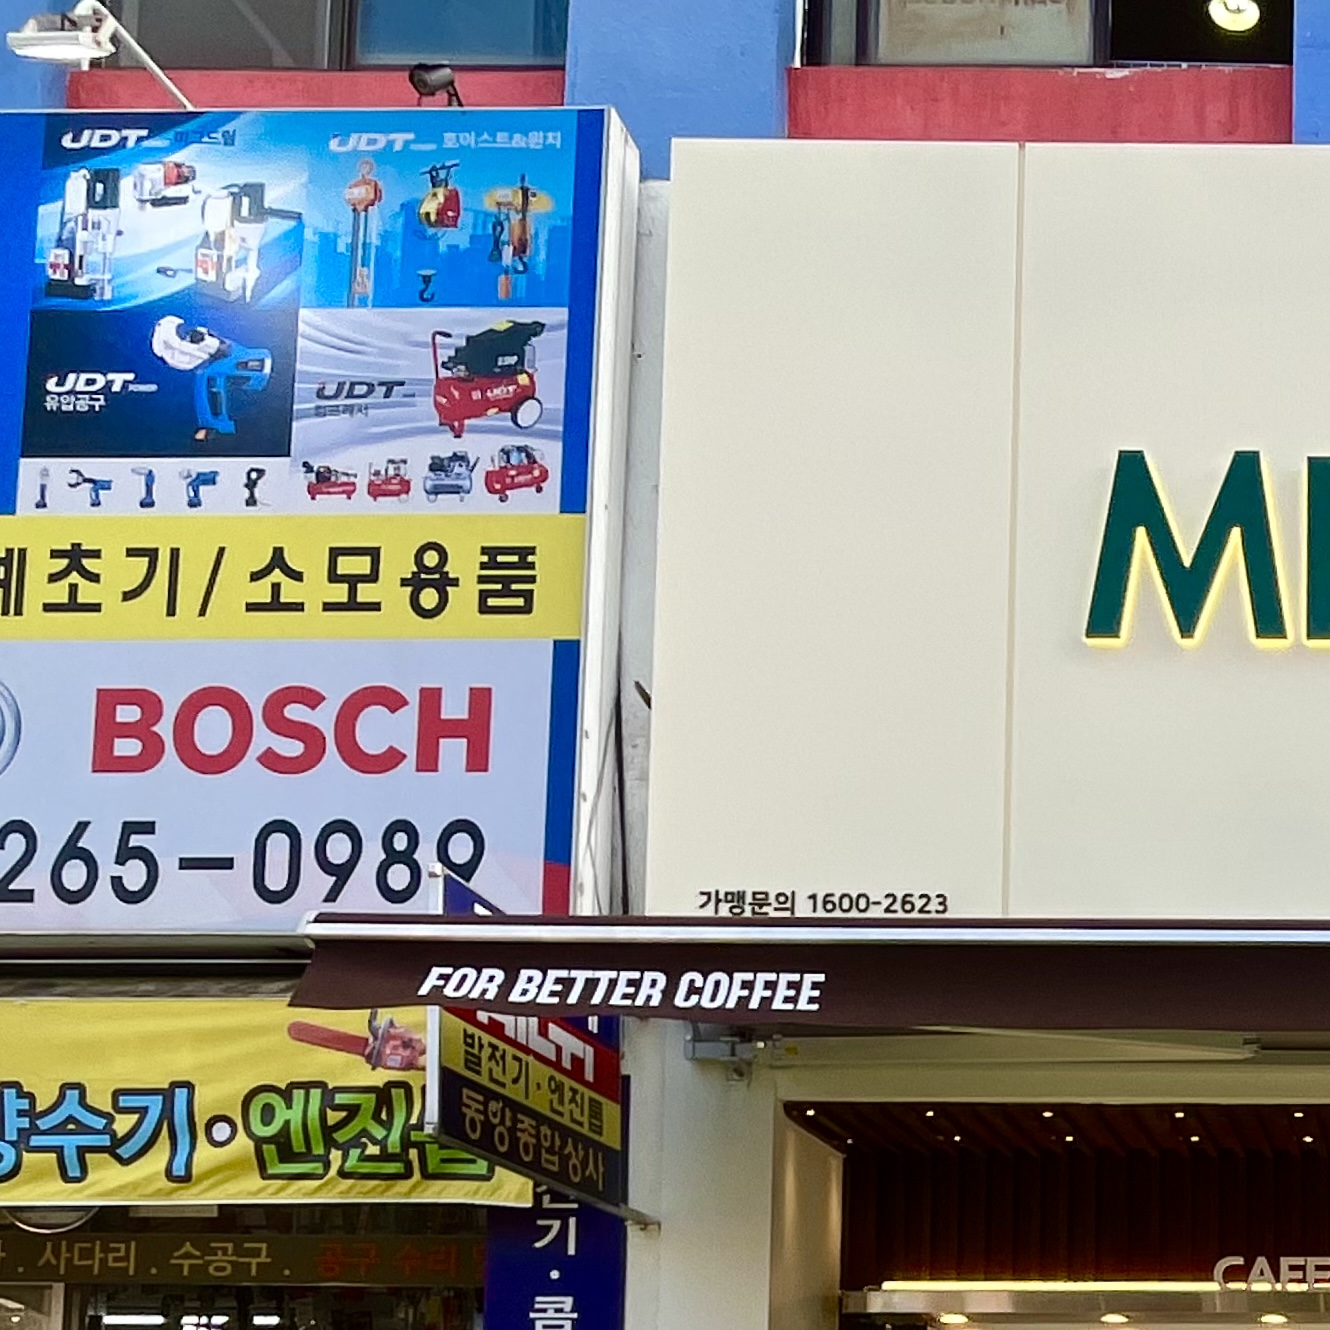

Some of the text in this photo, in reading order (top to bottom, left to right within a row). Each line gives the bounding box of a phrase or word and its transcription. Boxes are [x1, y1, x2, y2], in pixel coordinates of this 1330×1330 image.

[45, 372, 136, 393] UDT
[316, 381, 406, 400] UDT
[91, 685, 493, 775] BOSCH
[698, 889, 949, 917] 가맹문의 1600-2623
[418, 966, 826, 1011] FOR BETTER COFFEE
[38, 1241, 137, 1277] 사다리
[170, 1242, 272, 1277] 수공구
